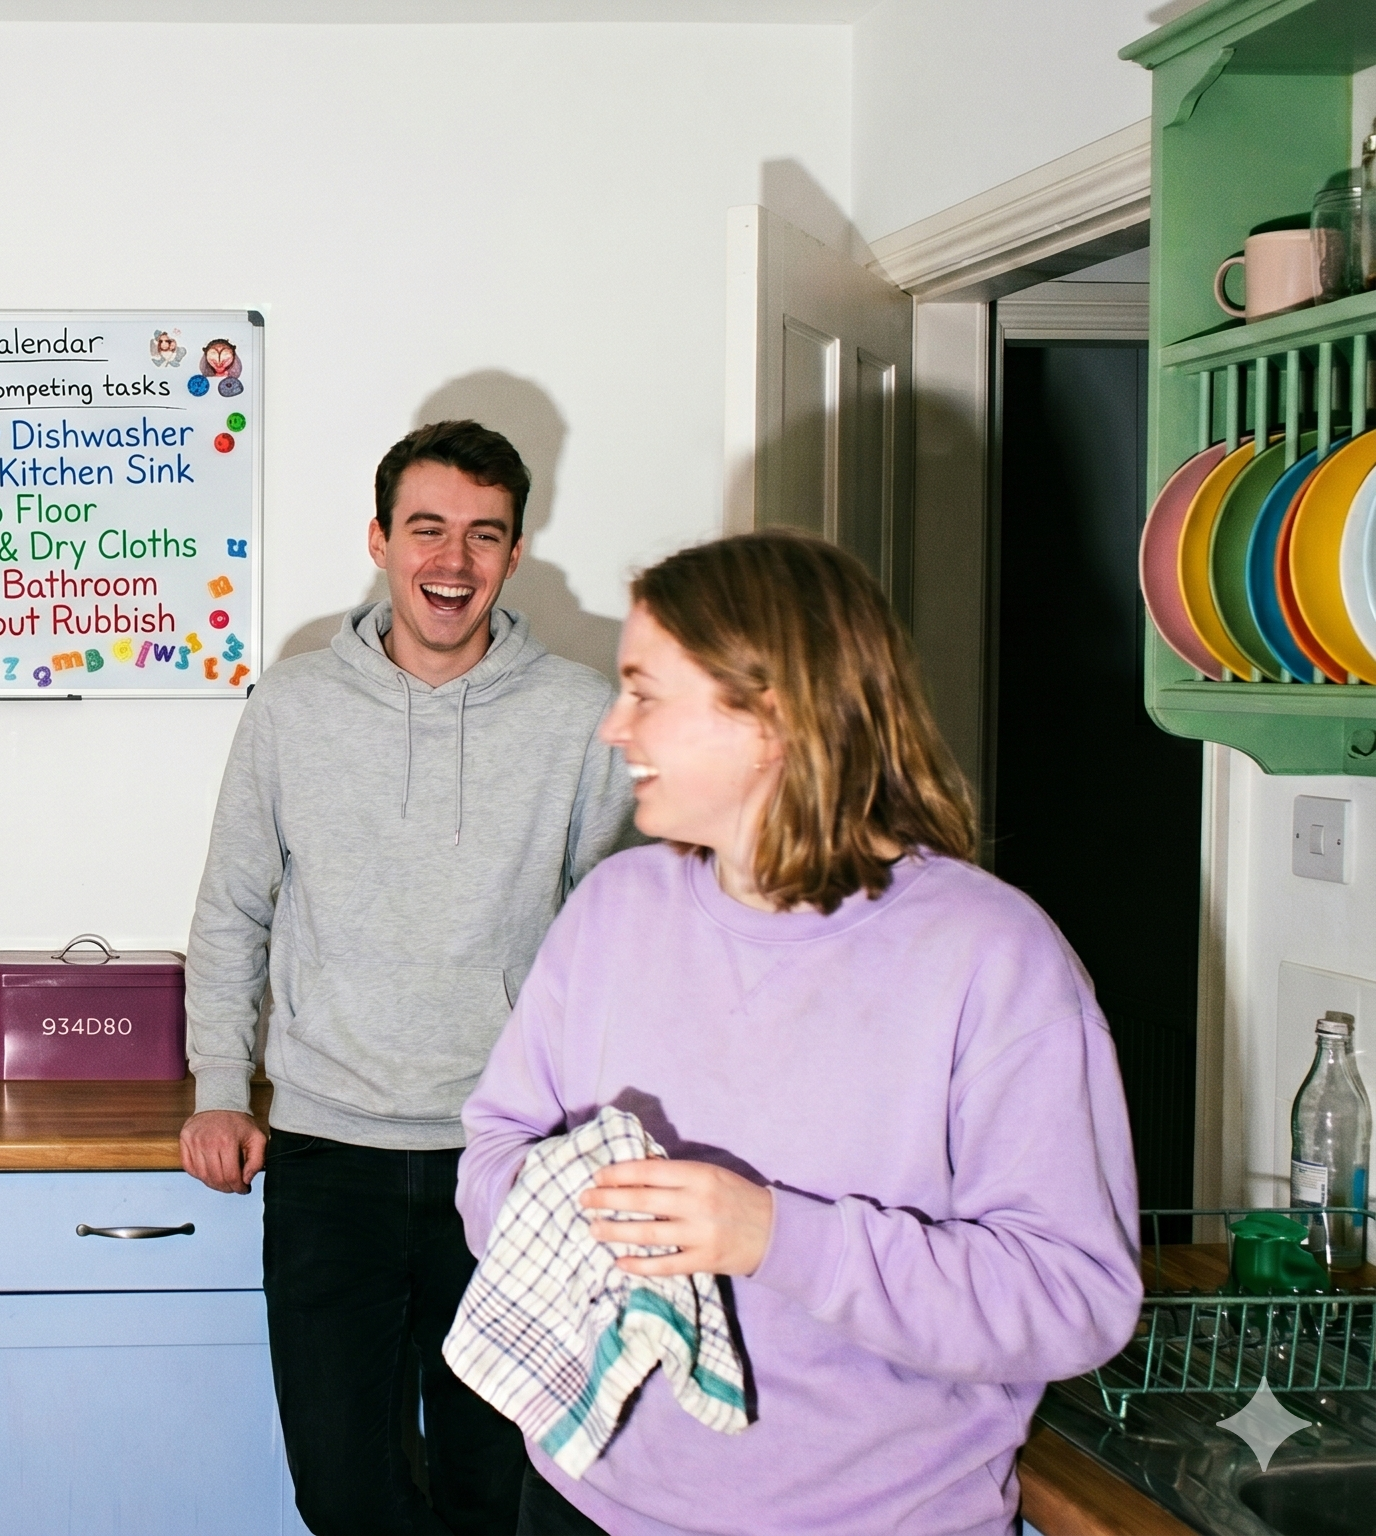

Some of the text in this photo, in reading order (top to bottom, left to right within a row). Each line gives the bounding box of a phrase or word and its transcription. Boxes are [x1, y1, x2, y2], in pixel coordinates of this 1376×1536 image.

[102, 374, 171, 397] tasks
[11, 416, 194, 451] Dishwasher
[126, 452, 195, 485] Sink
[16, 493, 98, 524] Floor
[30, 530, 87, 571] Dry
[98, 527, 197, 560] Cloths
[3, 566, 157, 599] Bathroom
[52, 602, 175, 636] Rubbish
[42, 1017, 132, 1036] 934D80
